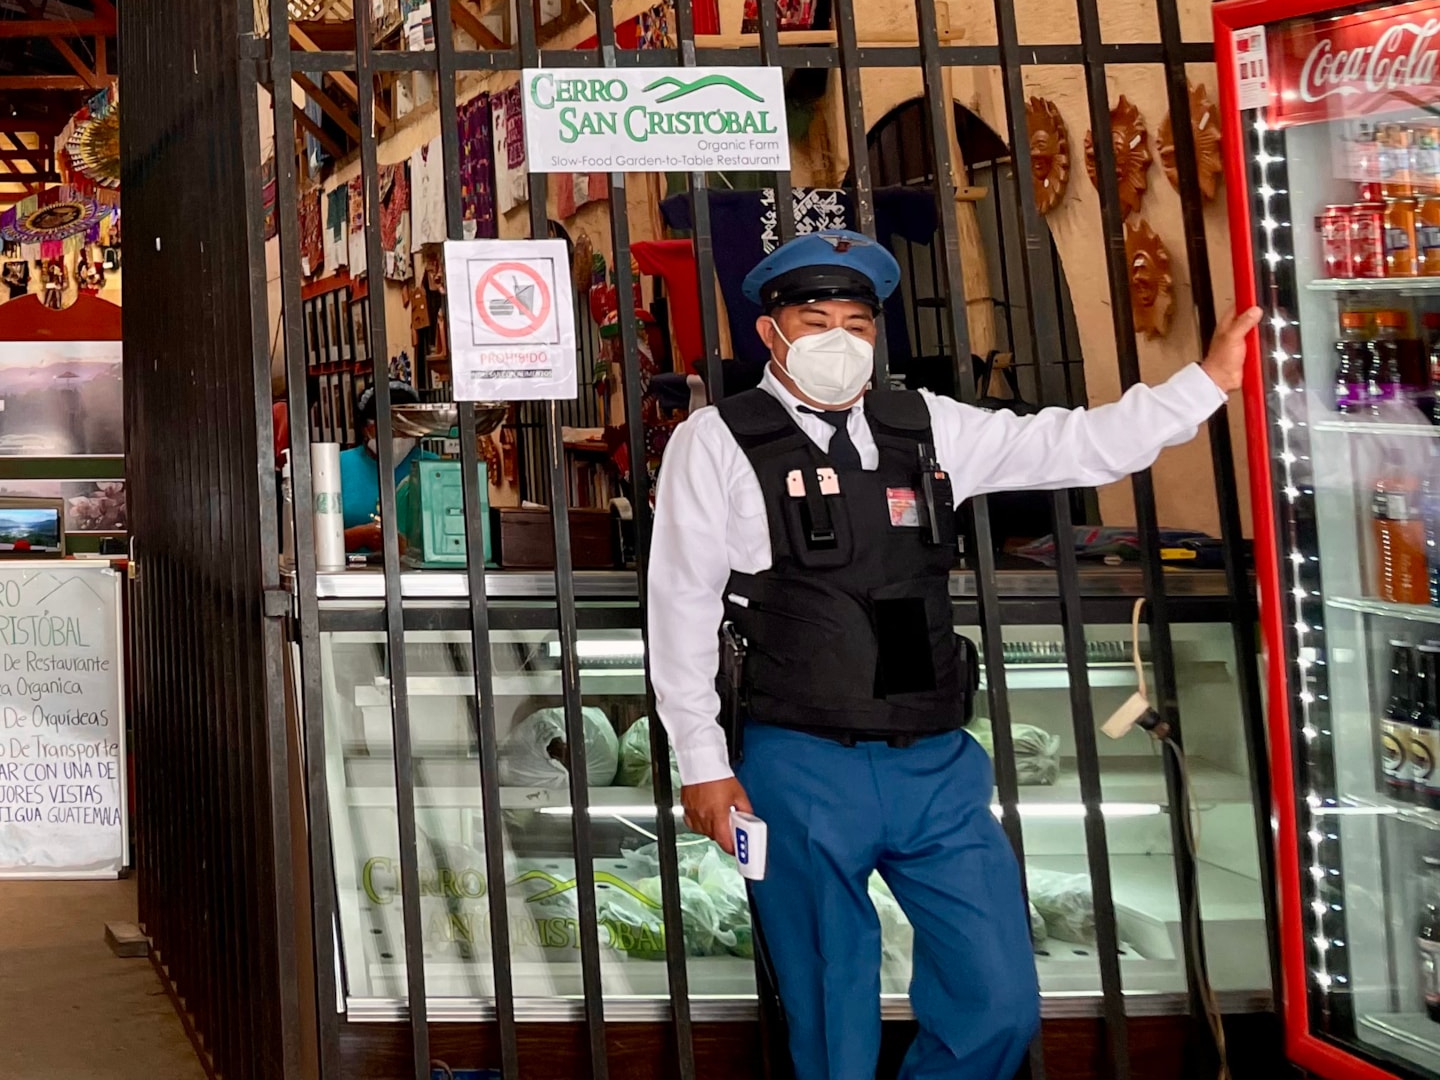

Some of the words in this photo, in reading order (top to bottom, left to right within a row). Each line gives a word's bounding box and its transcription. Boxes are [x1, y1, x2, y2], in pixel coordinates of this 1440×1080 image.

[1300, 18, 1440, 102] Coca-Cola
[530, 73, 628, 109] CERRO
[559, 107, 617, 143] SAN
[624, 105, 777, 142] CRISTÓBAL
[698, 139, 746, 152] Organic
[749, 139, 779, 150] Farm
[551, 155, 612, 166] Slow-Food
[616, 155, 713, 166] Garden-to-Table
[717, 154, 780, 166] Restaurant
[480, 351, 548, 365] PROHIBIDO
[4, 653, 20, 670] De
[26, 651, 110, 672] Restaurante
[17, 677, 83, 701] Organica
[3, 707, 26, 729] De
[10, 737, 31, 758] De
[35, 734, 119, 767] Transporte
[23, 762, 58, 782] CON
[63, 762, 93, 780] UNA
[97, 762, 117, 781] DE
[49, 784, 103, 804] VISTAS
[47, 806, 121, 827] GUATEMALA
[362, 856, 486, 905] CRRO
